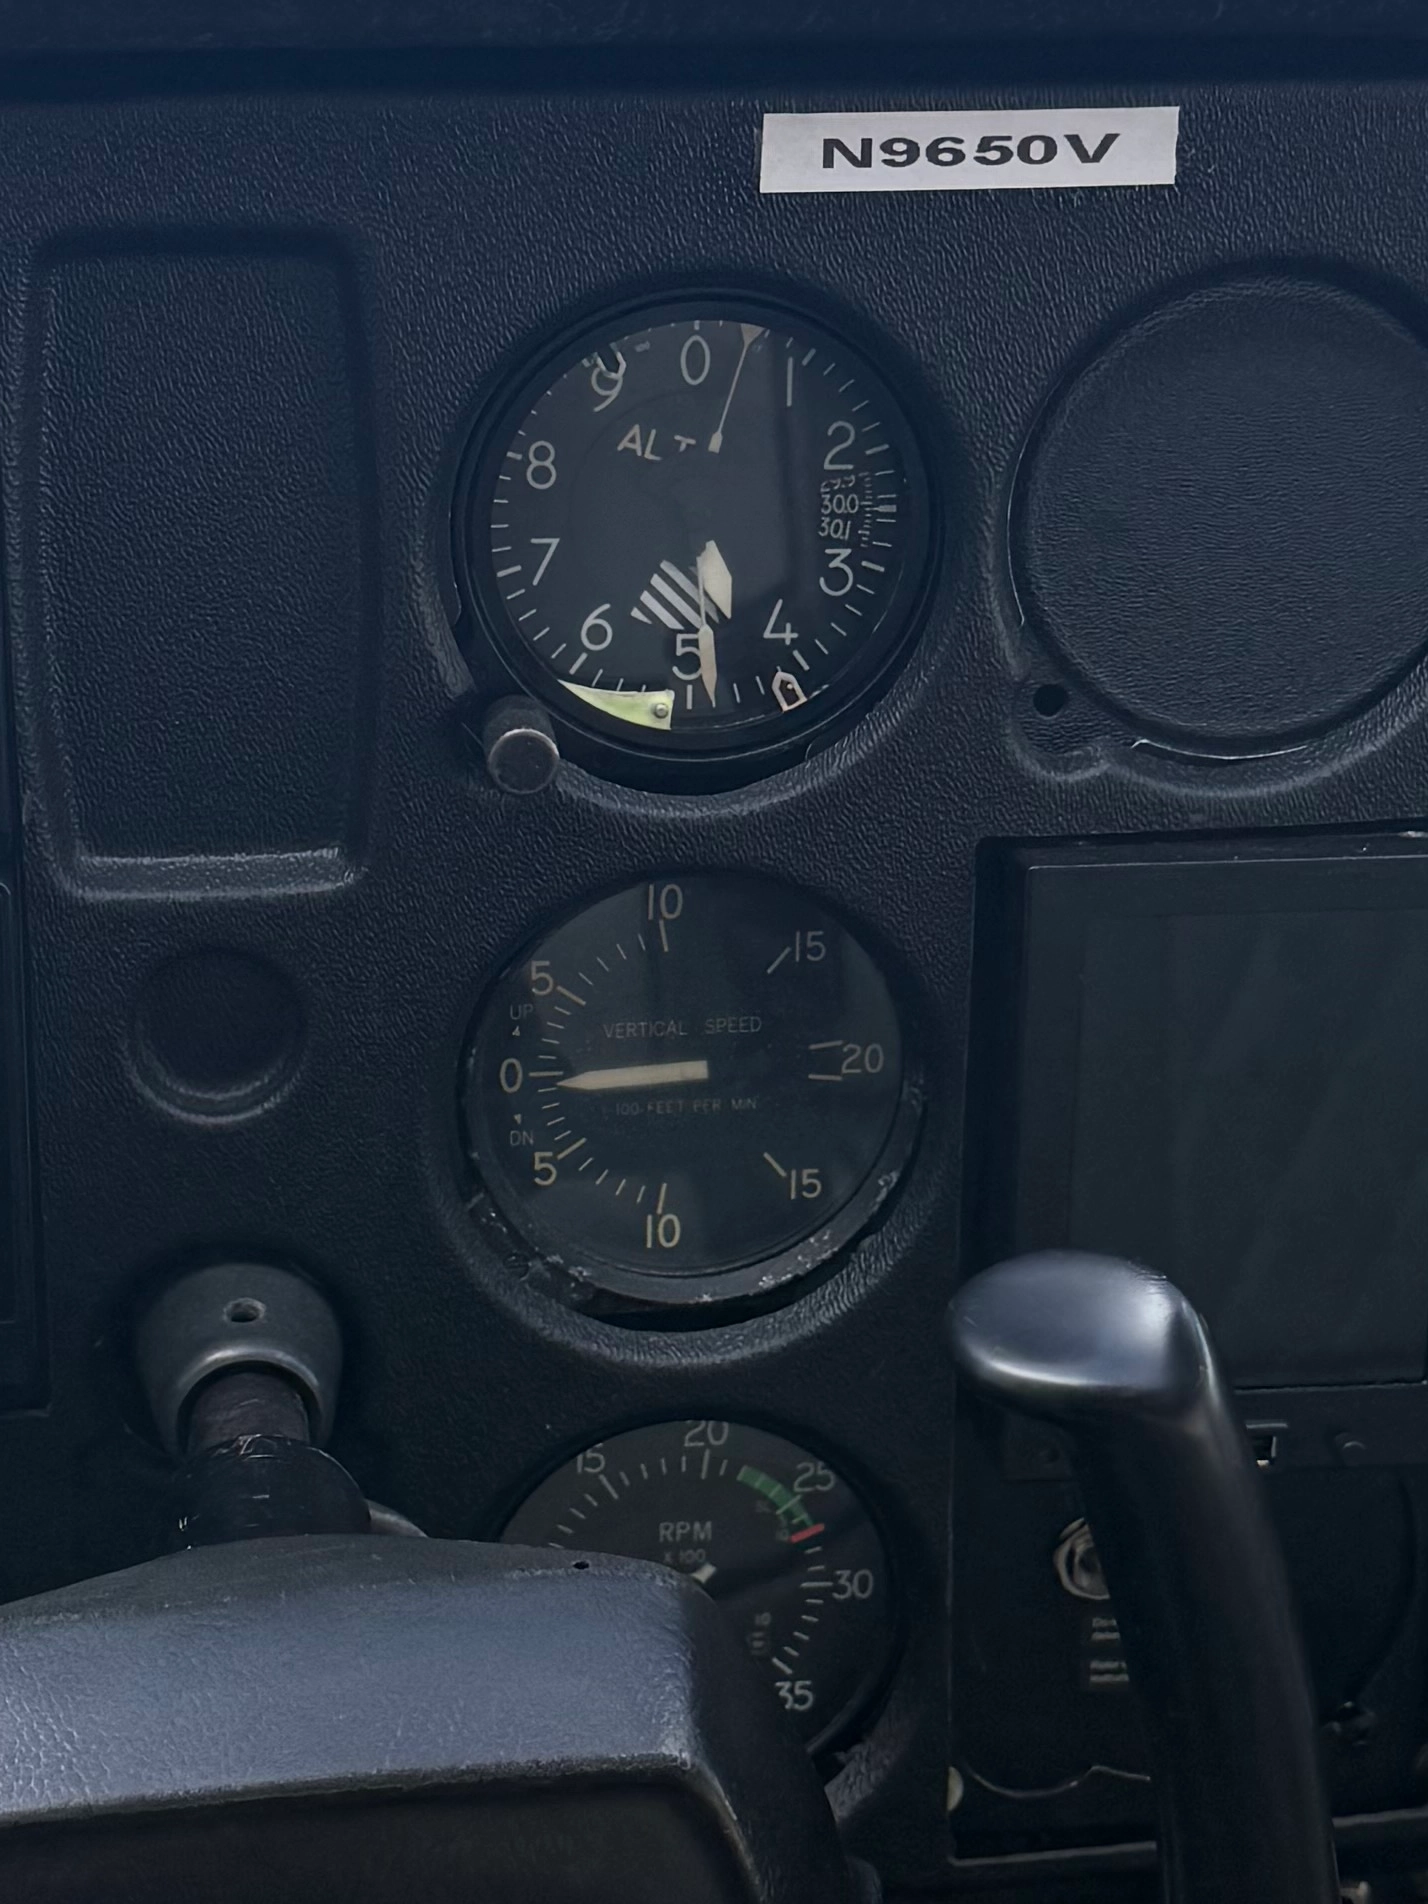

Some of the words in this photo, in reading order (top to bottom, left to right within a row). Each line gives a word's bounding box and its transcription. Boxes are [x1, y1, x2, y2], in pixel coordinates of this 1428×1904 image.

[821, 133, 1122, 170] N9650V
[679, 333, 711, 387] 0
[822, 420, 856, 471] 2
[525, 439, 557, 490] 8
[529, 536, 562, 586] 7
[818, 546, 854, 597] 3
[579, 602, 613, 652] 6
[761, 597, 799, 647] 4
[671, 631, 703, 682] 5
[647, 883, 684, 921] 10
[794, 929, 828, 964] 15
[529, 960, 555, 996] 5
[509, 1002, 534, 1020] UP
[602, 1020, 689, 1040] VERTICAL
[704, 1015, 763, 1035] SPEED
[498, 1057, 524, 1095] 0
[840, 1043, 885, 1076] 20
[509, 1130, 535, 1146] DN
[532, 1151, 557, 1187] 5
[789, 1168, 823, 1201] 15
[645, 1212, 682, 1249] 10
[683, 1420, 729, 1448] 20
[792, 1461, 837, 1493] 25
[658, 1520, 713, 1545] RPM
[831, 1568, 874, 1601] 30
[773, 1679, 816, 1713] 35
